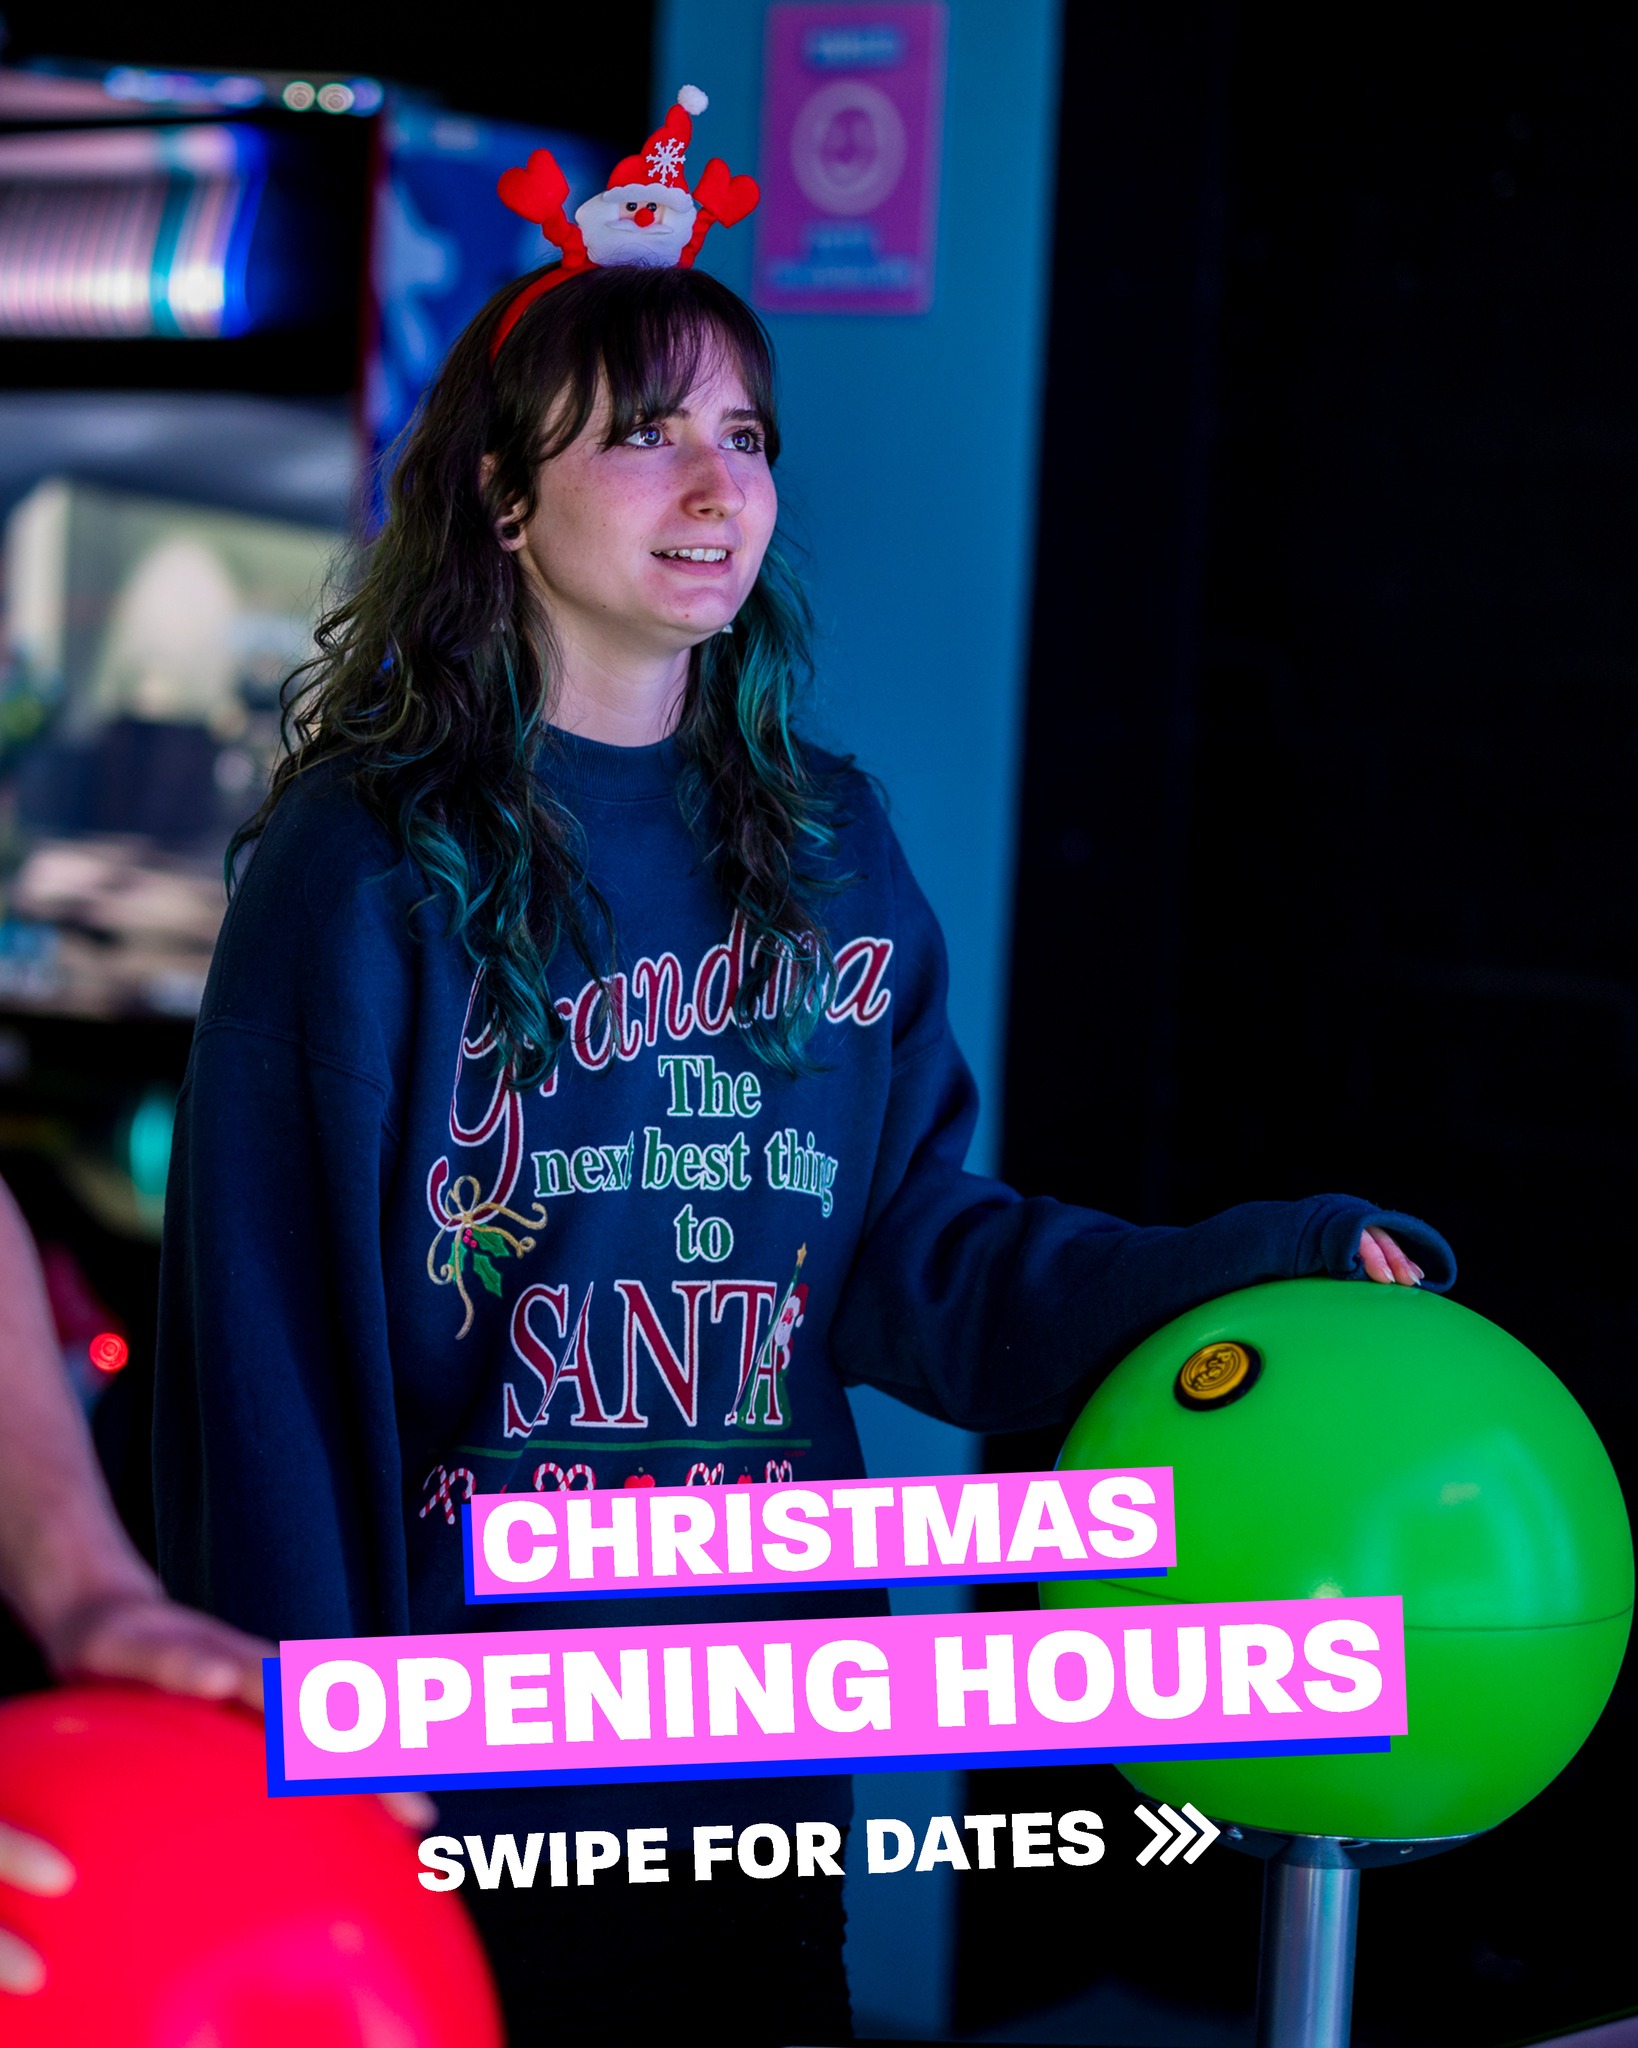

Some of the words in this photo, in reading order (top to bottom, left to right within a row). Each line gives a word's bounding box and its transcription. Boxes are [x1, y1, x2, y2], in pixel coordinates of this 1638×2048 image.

[657, 1054, 762, 1118] The
[641, 1126, 752, 1192] best
[673, 1203, 735, 1264] to
[503, 1280, 787, 1438] SANTA
